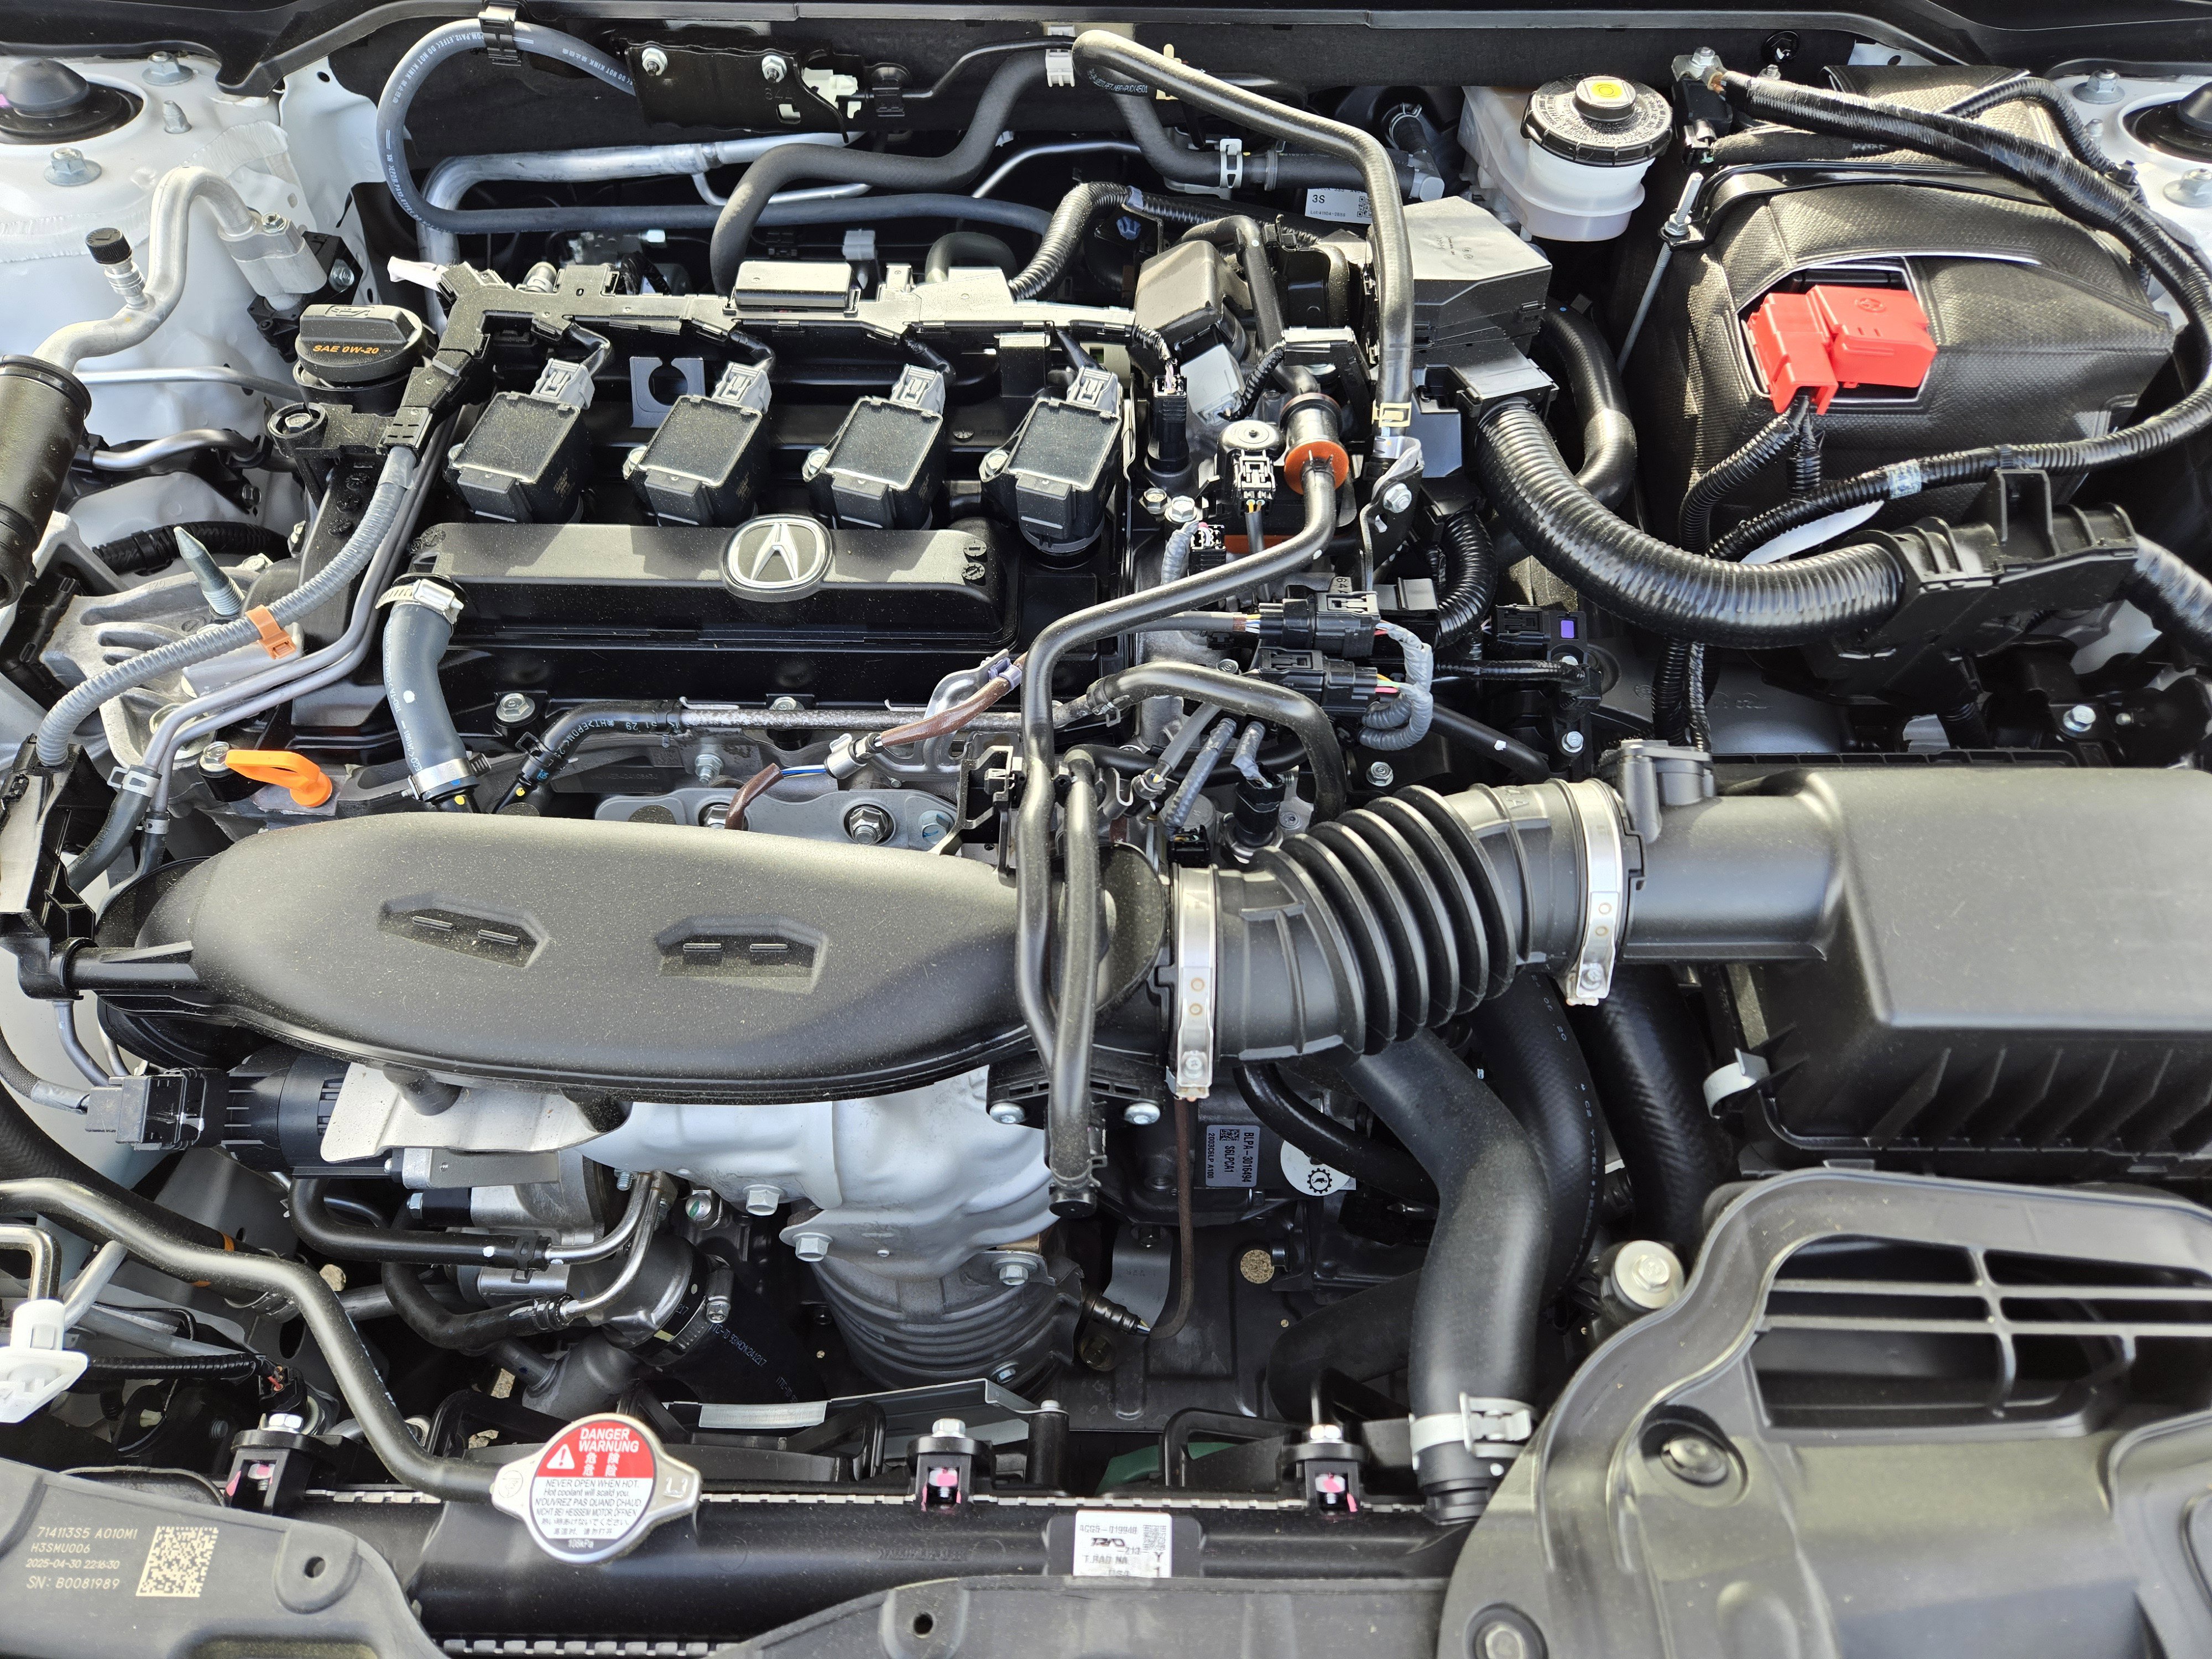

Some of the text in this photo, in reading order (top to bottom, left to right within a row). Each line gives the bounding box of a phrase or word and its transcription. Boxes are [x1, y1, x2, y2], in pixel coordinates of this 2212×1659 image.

[419, 52, 430, 65] NOT
[589, 59, 606, 71] KINK
[405, 65, 419, 80] KINK
[606, 67, 618, 77] NOT
[1312, 194, 1325, 204] 3S
[341, 346, 379, 354] 0W-20
[580, 1428, 630, 1441] DANGER
[578, 1440, 640, 1453] WARNUNG
[546, 1479, 572, 1488] NEVER
[574, 1479, 596, 1488] OPEN
[598, 1480, 620, 1488] WHEN
[596, 1489, 615, 1497] scald
[573, 1499, 588, 1507] PAS
[589, 1499, 615, 1507] QUAND
[536, 1507, 554, 1516] NICHT
[554, 1507, 565, 1516] BEI
[592, 1509, 613, 1517] MOTOR
[30, 1542, 91, 1554] H3SMU006
[1154, 1551, 1164, 1563] Y
[25, 1558, 82, 1569] 2025-04-30
[27, 1575, 121, 1590] SN: B0081989
